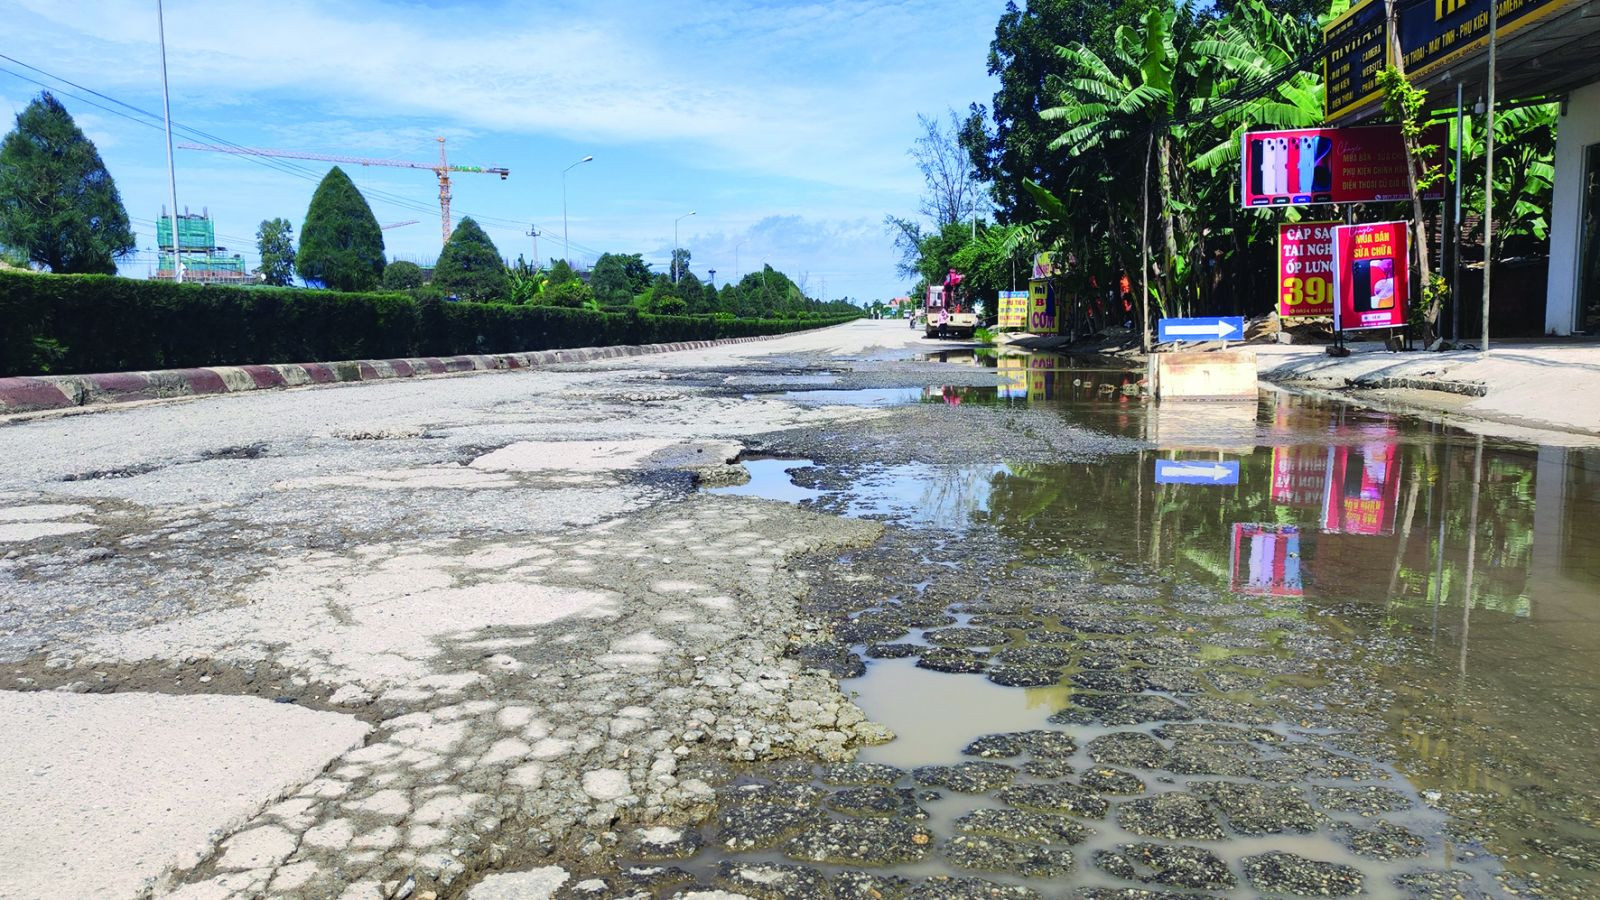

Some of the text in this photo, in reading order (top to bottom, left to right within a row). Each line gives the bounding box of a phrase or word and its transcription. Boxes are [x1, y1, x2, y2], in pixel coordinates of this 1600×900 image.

[1355, 231, 1390, 244] MUA BÁN
[1283, 244, 1304, 257] TAI
[1353, 244, 1392, 258] SỬA CHỮA
[1285, 258, 1302, 274] ỐP
